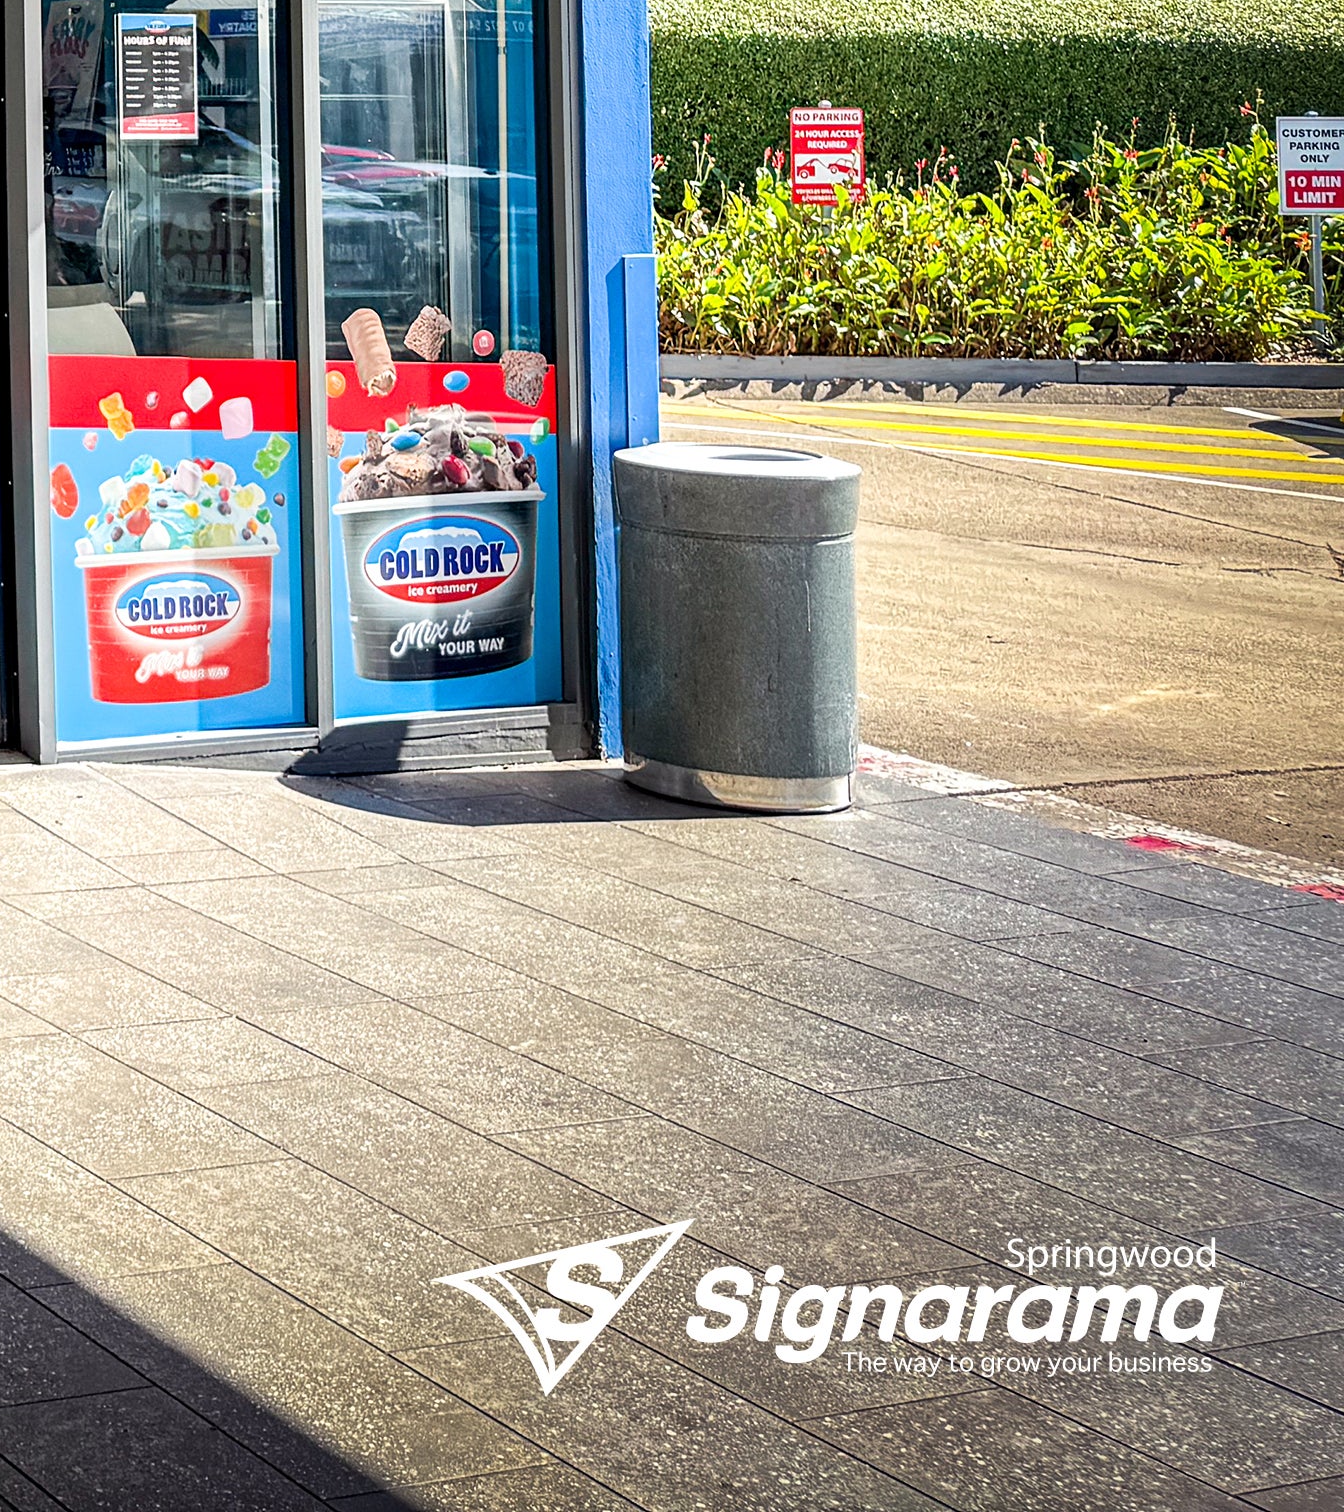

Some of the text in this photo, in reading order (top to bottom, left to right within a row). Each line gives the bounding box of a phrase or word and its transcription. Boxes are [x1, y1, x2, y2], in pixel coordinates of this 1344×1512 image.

[123, 35, 192, 45] HOURS OF FUN!
[794, 112, 859, 121] NO PARKING
[794, 130, 860, 138] 24 HOUR ACCESS
[807, 140, 848, 149] REQUIRED
[1289, 141, 1340, 150] PARKING
[1300, 154, 1330, 163] ONLY
[1288, 175, 1342, 188] 10 MIN
[1293, 191, 1337, 204] LIMIT
[380, 542, 505, 581] COLD ROCK
[408, 583, 478, 597] ice creamery
[128, 593, 229, 622] COLD ROCK
[150, 624, 207, 635] ice creamery
[390, 609, 473, 657] Mix it
[438, 637, 505, 656] YOUR WAY
[175, 666, 230, 681] YOUR WAY
